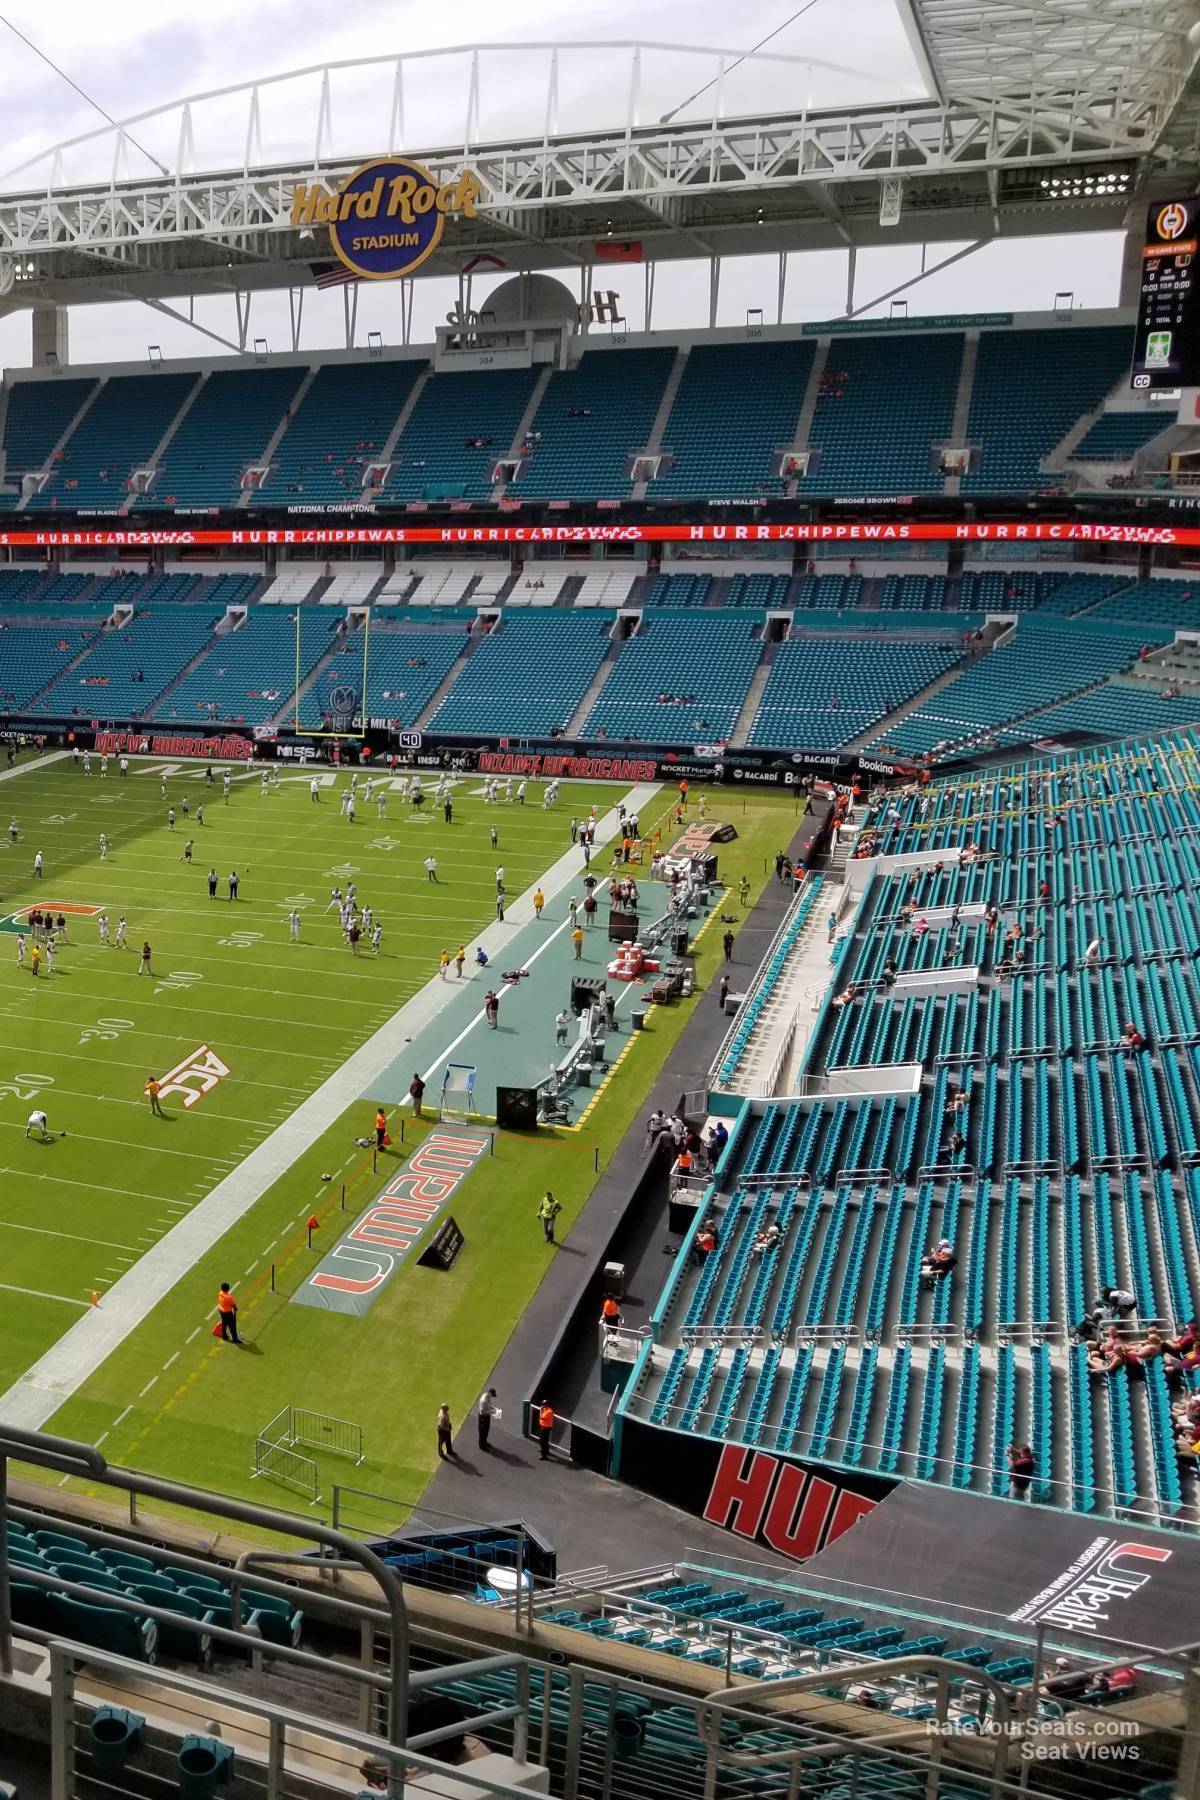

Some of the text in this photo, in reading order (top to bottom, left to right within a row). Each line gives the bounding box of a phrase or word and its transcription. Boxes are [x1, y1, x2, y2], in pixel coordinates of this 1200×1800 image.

[289, 168, 481, 226] Hard Rock
[352, 232, 420, 250] STADIUM
[479, 357, 494, 365] 304
[1135, 377, 1149, 387] CC
[287, 504, 376, 514] NATIONAL CHAMPIONS
[866, 496, 897, 504] BROWN
[152, 735, 252, 760] HURRICANES
[403, 734, 418, 746] 40
[477, 752, 657, 780] MIAMI HURRICANES
[804, 755, 841, 764] BACARDÍ
[661, 764, 691, 774] ROCKET
[745, 771, 778, 781] BACARDÍ
[218, 930, 266, 949] 50
[164, 970, 204, 992] 40
[81, 1016, 135, 1041] 30
[148, 1044, 231, 1107] ACC
[1074, 1536, 1110, 1568] UNIVERSITY
[1067, 1565, 1082, 1574] OF
[1048, 1572, 1075, 1590] MIAMI
[1028, 1587, 1058, 1606] HEALTH
